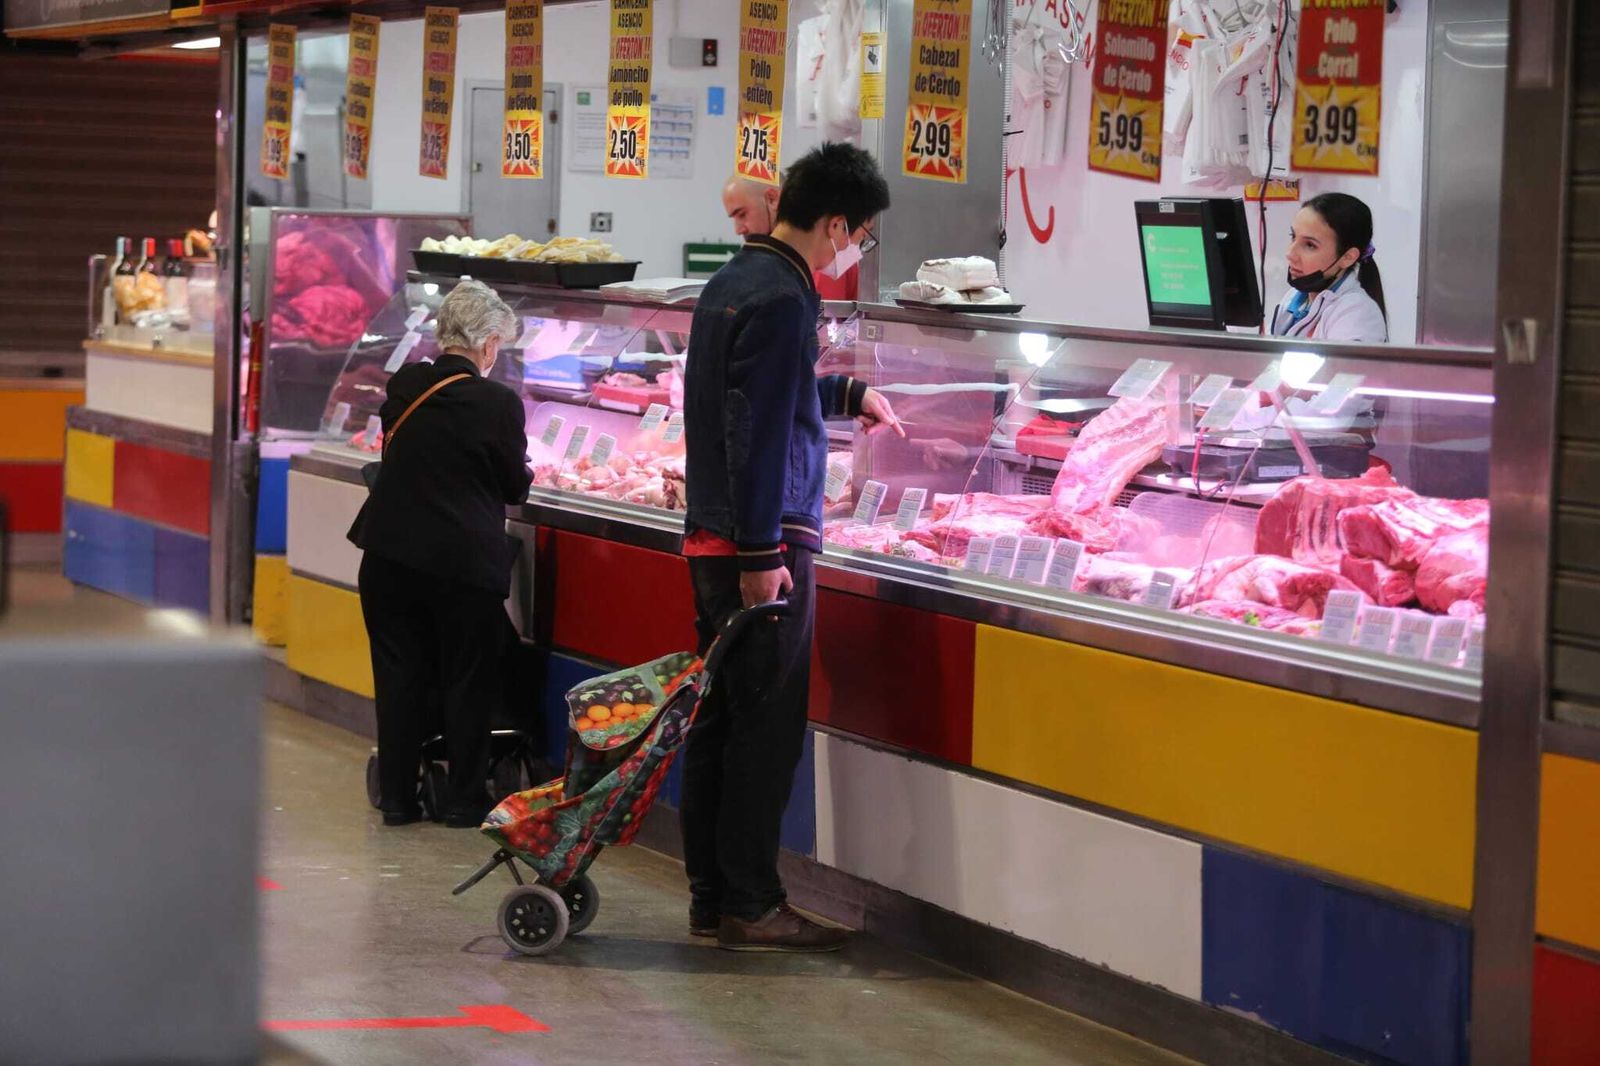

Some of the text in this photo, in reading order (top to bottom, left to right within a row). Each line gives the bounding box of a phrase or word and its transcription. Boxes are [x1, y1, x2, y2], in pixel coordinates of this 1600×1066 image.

[617, 13, 643, 28] ASENCIO
[749, 2, 778, 21] ASENCIO
[919, 45, 960, 68] Cabezal
[610, 66, 648, 84] Jamoncito
[750, 58, 772, 79] Pollo
[1103, 64, 1116, 88] de
[746, 86, 773, 106] entero
[914, 73, 961, 97] de Cerdo
[516, 95, 537, 111] Cerdo
[613, 89, 643, 108] de pollo
[1099, 111, 1143, 152] 5,99
[1304, 104, 1357, 147] 3,99
[506, 132, 531, 161] 3,50
[610, 129, 637, 160] 2,50
[742, 126, 768, 162] 2,75
[910, 120, 950, 158] 2,99
